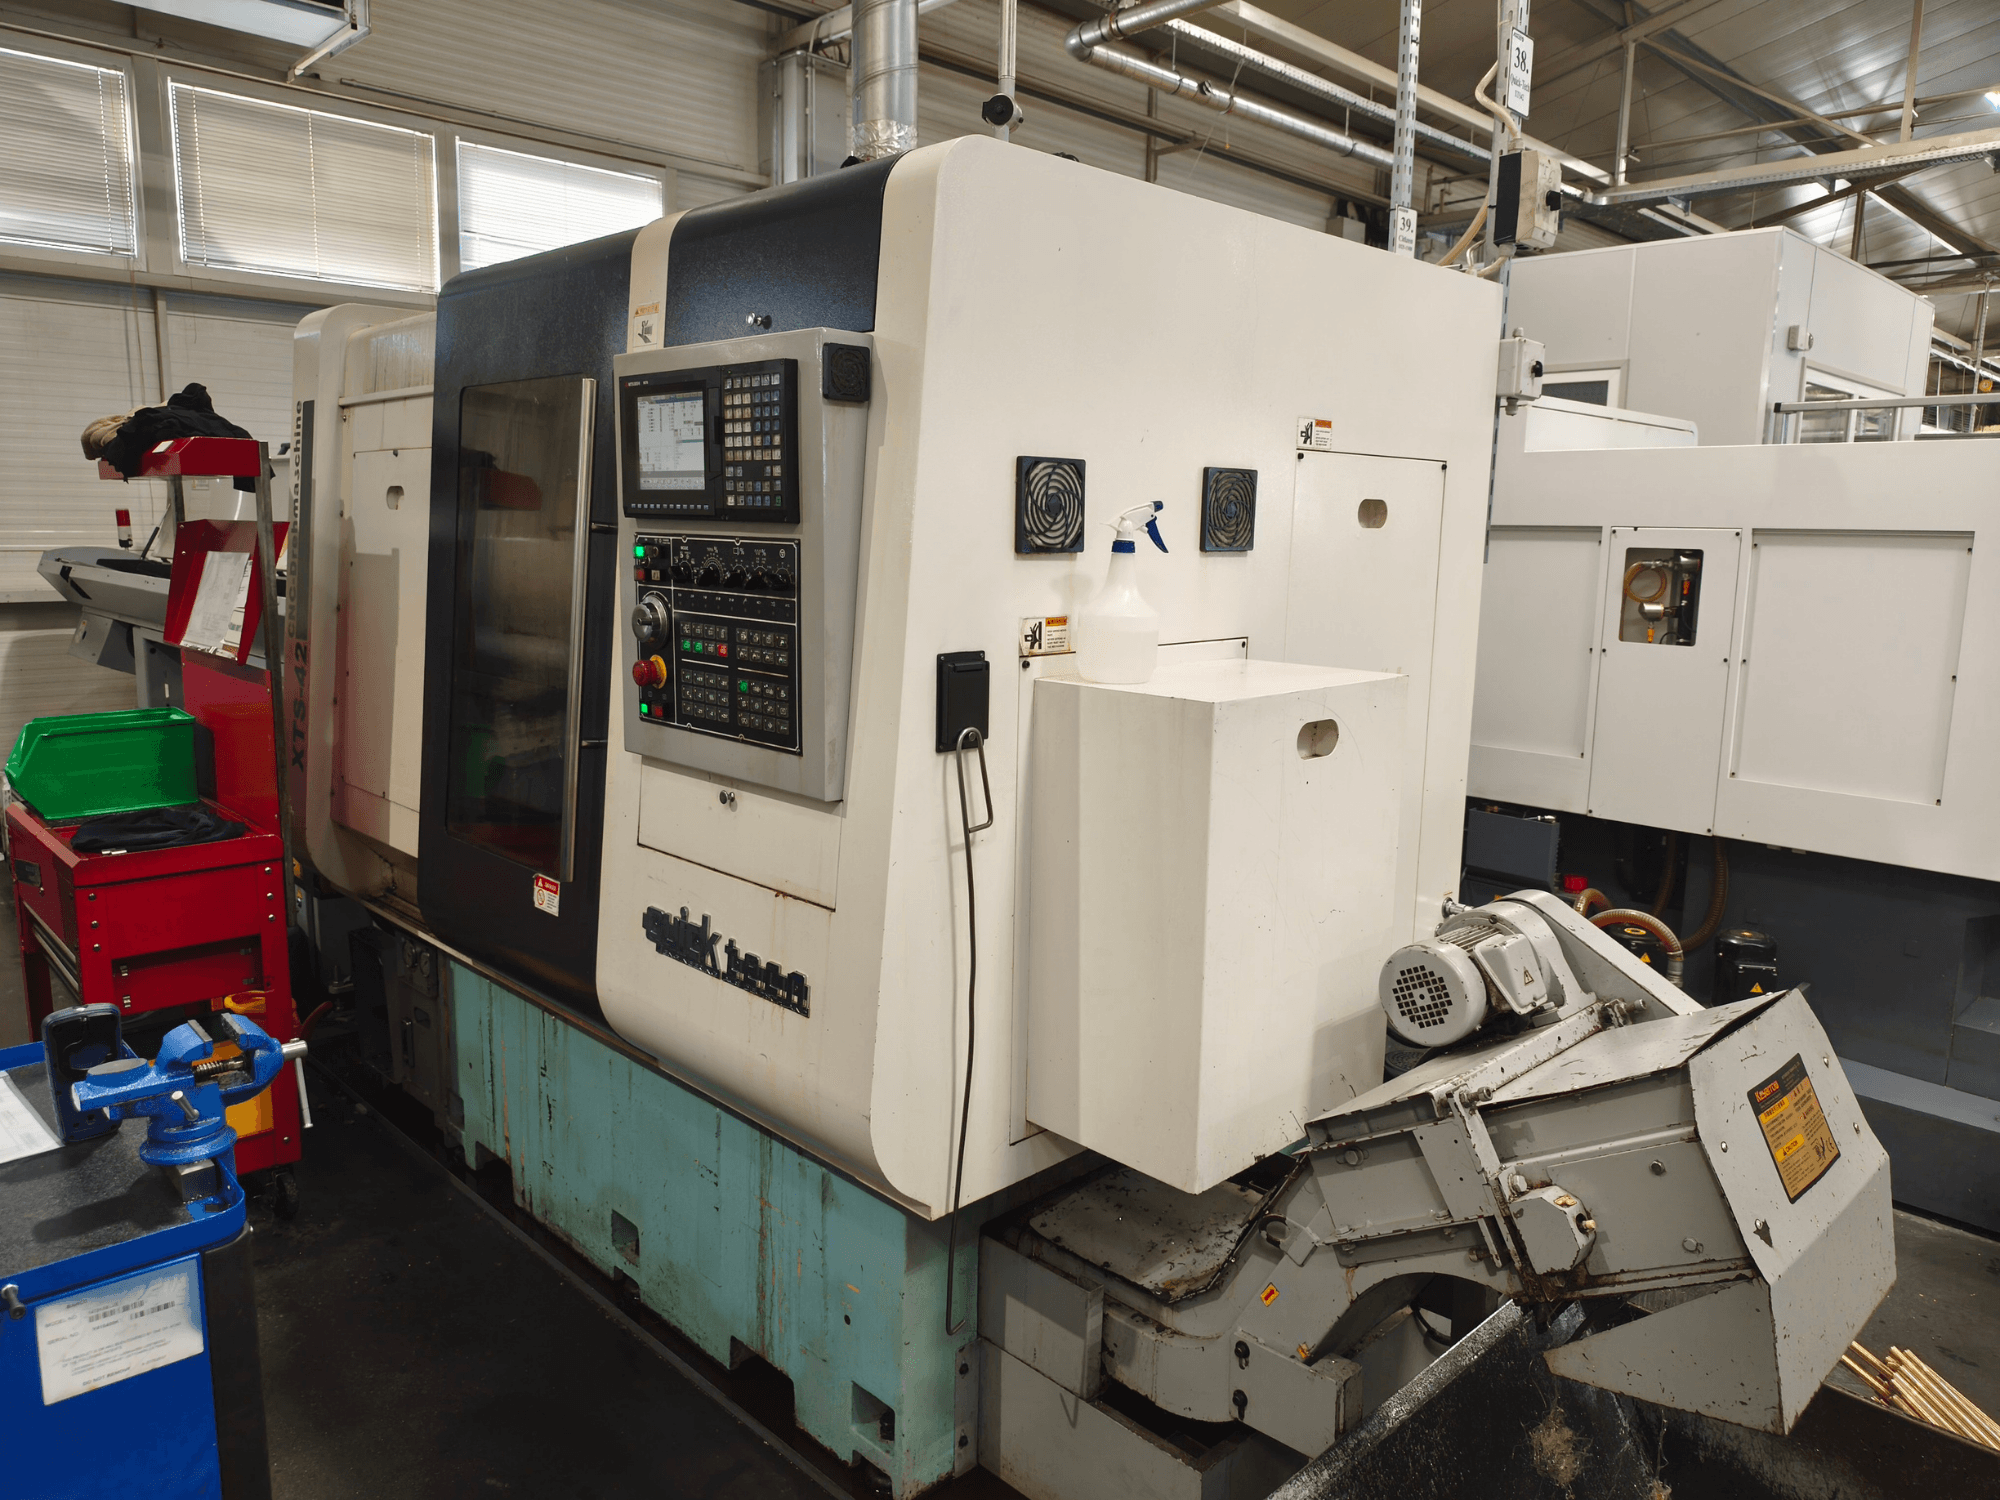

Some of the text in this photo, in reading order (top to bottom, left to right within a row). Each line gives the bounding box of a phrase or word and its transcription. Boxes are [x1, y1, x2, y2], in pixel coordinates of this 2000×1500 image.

[1513, 47, 1529, 74] 38.
[1399, 216, 1414, 234] 39.
[287, 399, 304, 640] CNC-Drehmaschine
[291, 640, 309, 773] XTS-42
[642, 905, 722, 980] quick
[93, 1375, 106, 1383] NOT
